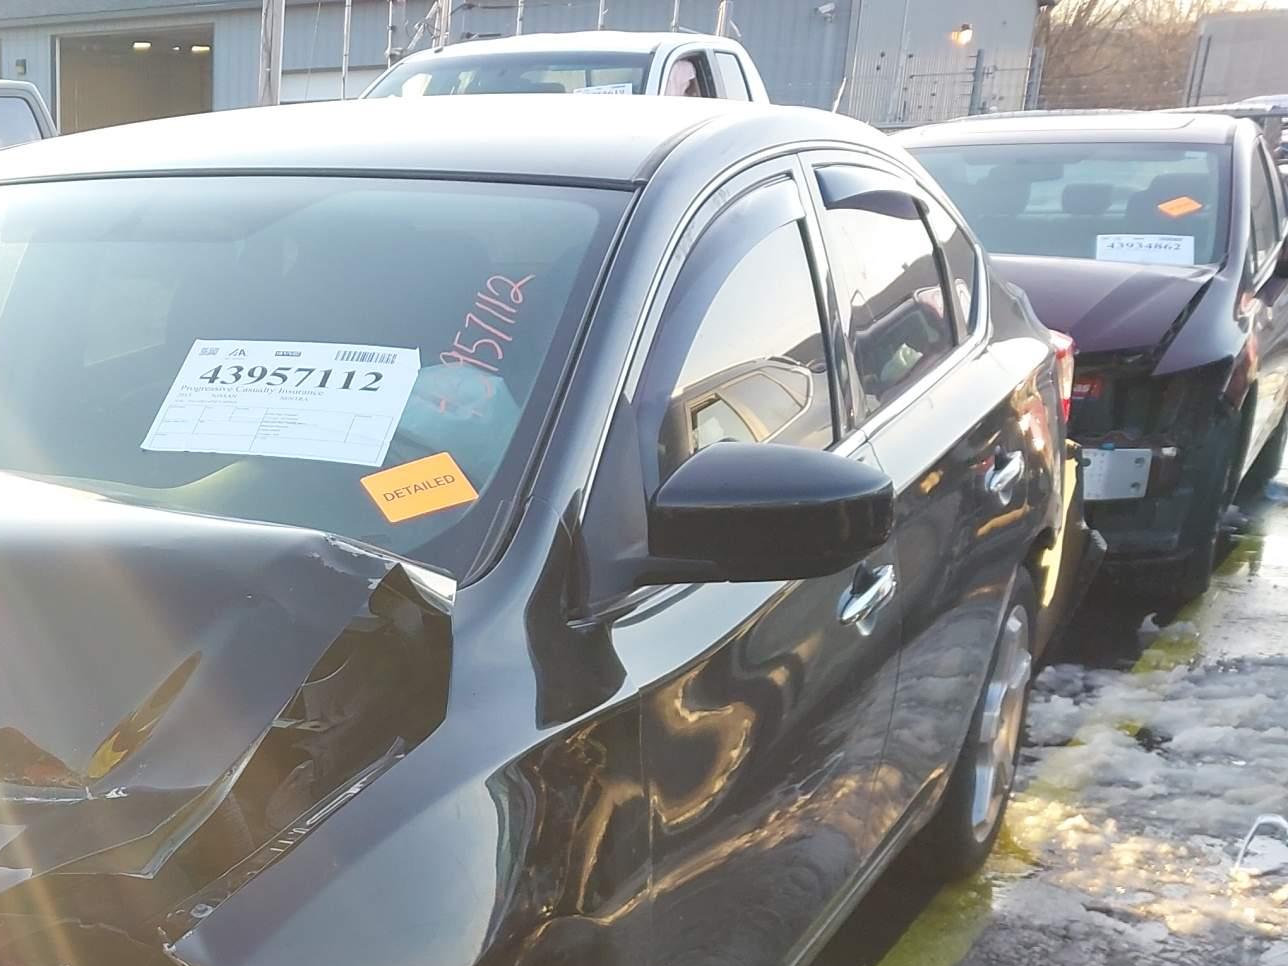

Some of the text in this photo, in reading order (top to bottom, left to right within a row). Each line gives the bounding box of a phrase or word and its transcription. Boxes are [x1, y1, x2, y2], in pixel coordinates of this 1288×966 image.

[199, 364, 384, 392] 43957112
[277, 387, 325, 397] Insurance
[383, 474, 456, 502] DETAILED
